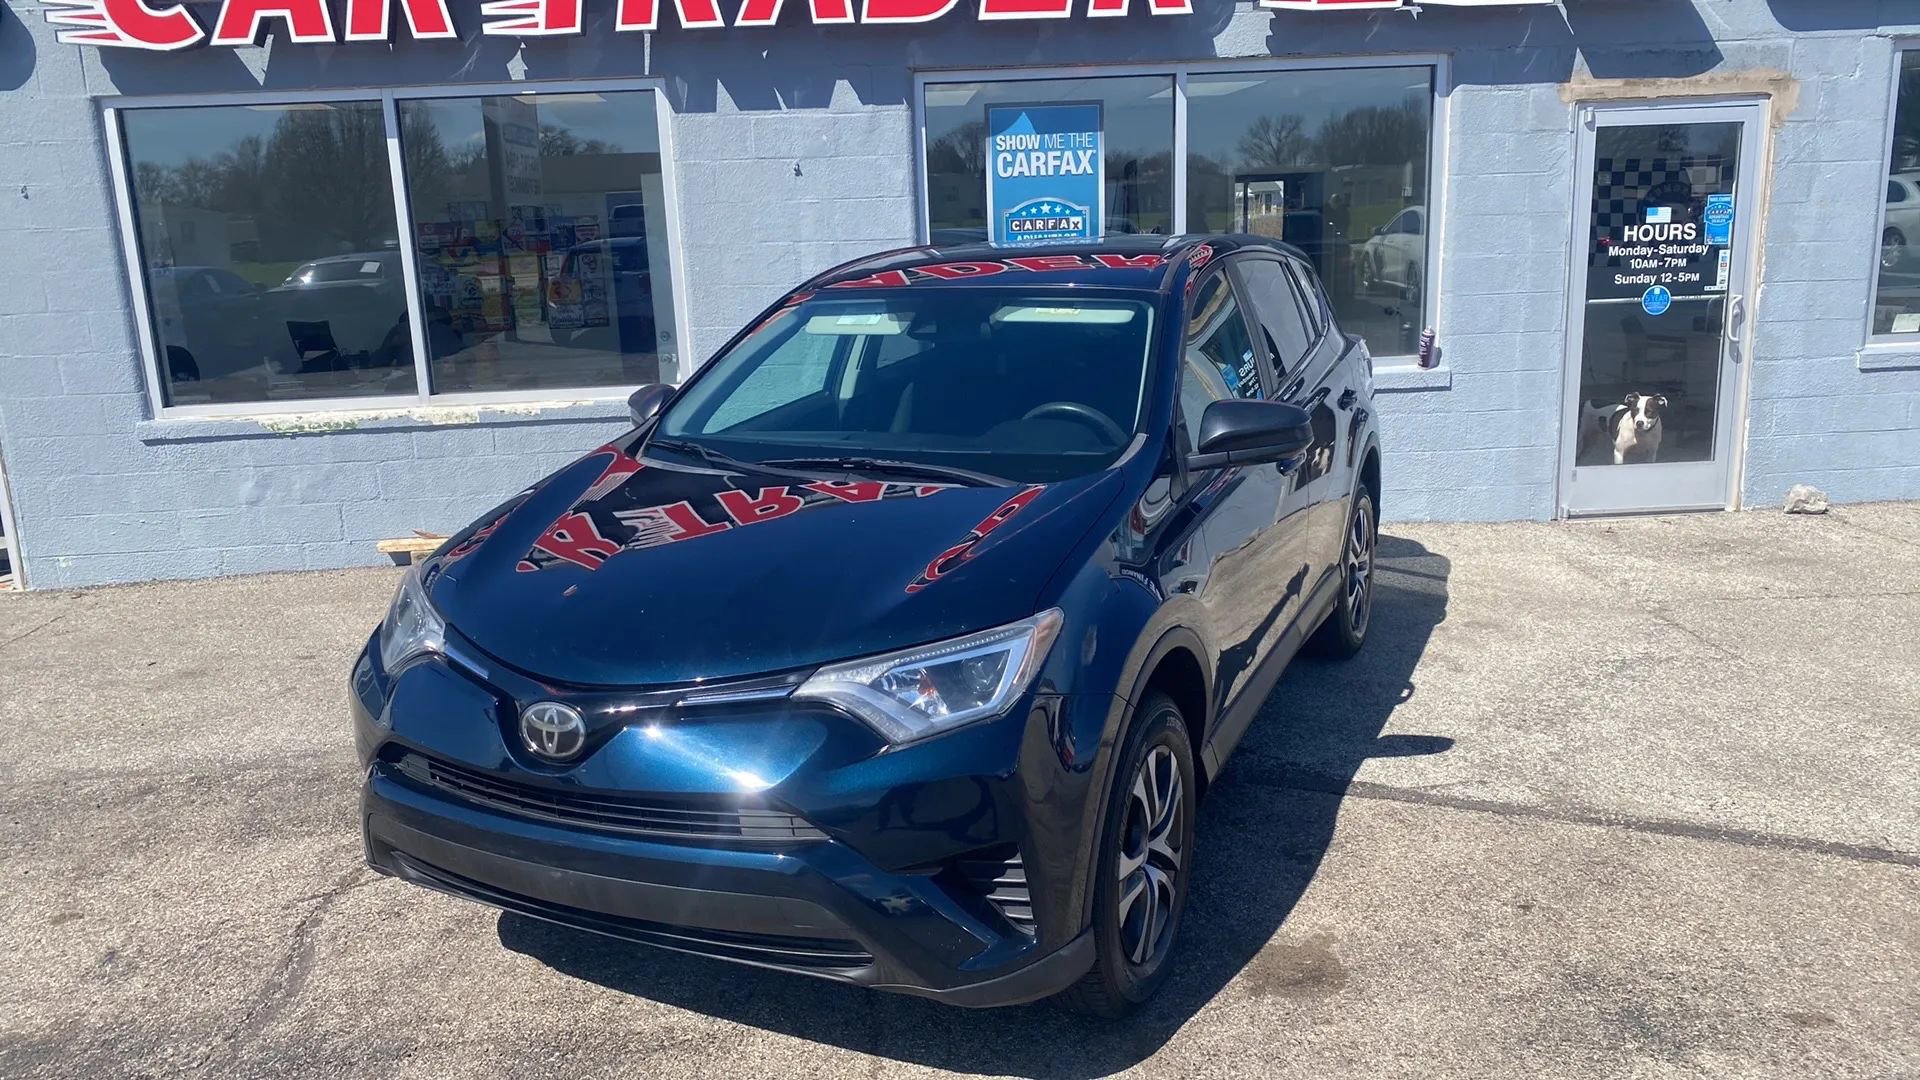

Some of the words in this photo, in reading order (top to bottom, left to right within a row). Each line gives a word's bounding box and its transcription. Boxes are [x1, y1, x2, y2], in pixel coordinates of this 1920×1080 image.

[996, 134, 1040, 151] SHOW
[1044, 134, 1065, 149] ME
[1068, 132, 1094, 148] THE
[997, 150, 1096, 178] CARFAX
[1011, 218, 1081, 231] CARFAX
[1624, 223, 1696, 242] HOURS
[1608, 244, 1709, 257] Monday-Saturday
[1629, 257, 1687, 269] 10AM-7PM
[1614, 273, 1657, 285] Sunday
[1660, 272, 1700, 283] 12-5PM
